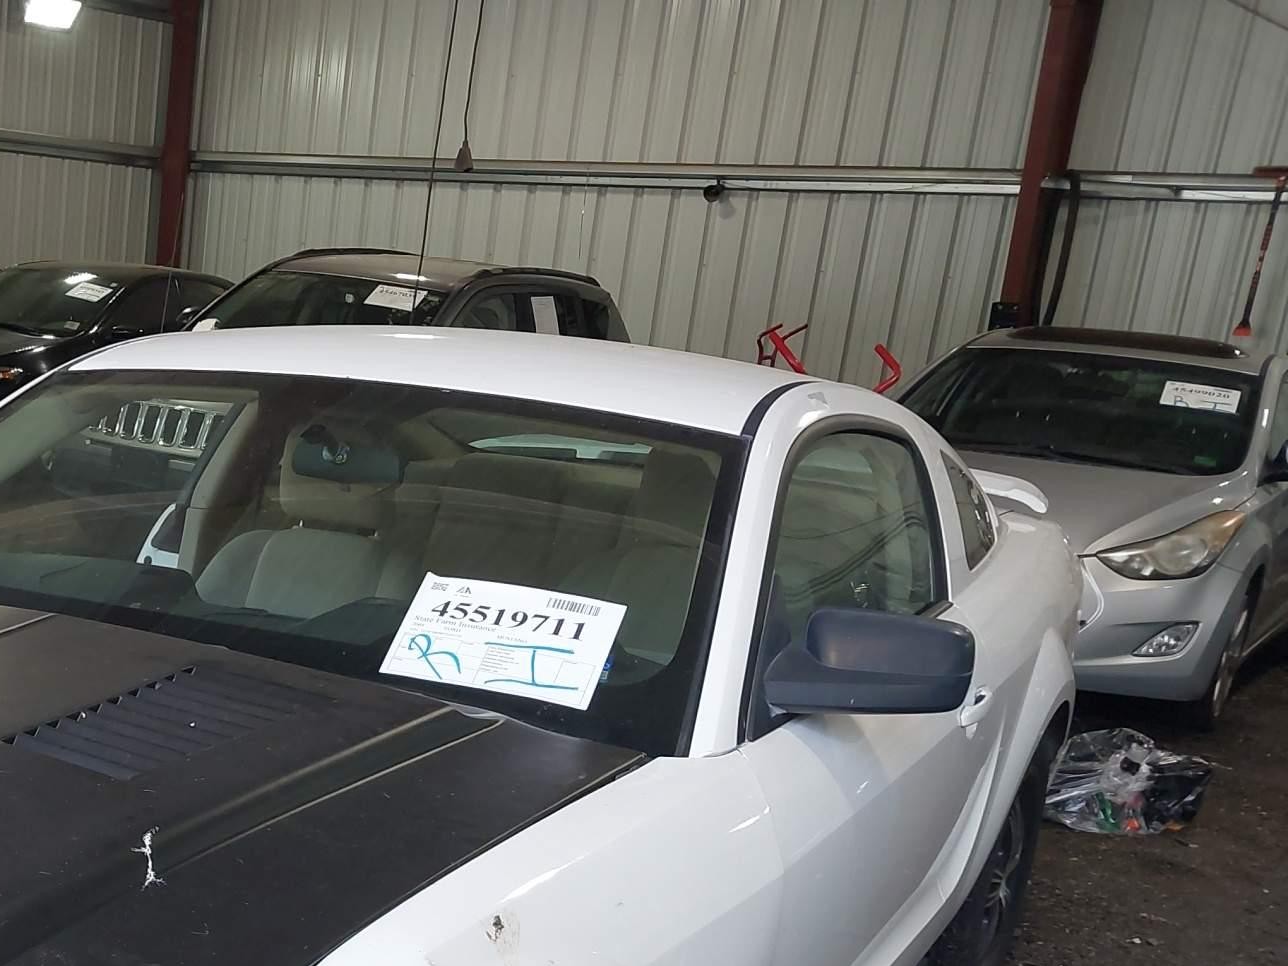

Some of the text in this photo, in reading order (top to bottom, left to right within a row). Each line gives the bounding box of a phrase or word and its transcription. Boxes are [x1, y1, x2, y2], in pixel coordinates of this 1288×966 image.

[414, 615, 434, 624] State
[435, 618, 457, 627] Farm
[431, 600, 587, 642] 45519711
